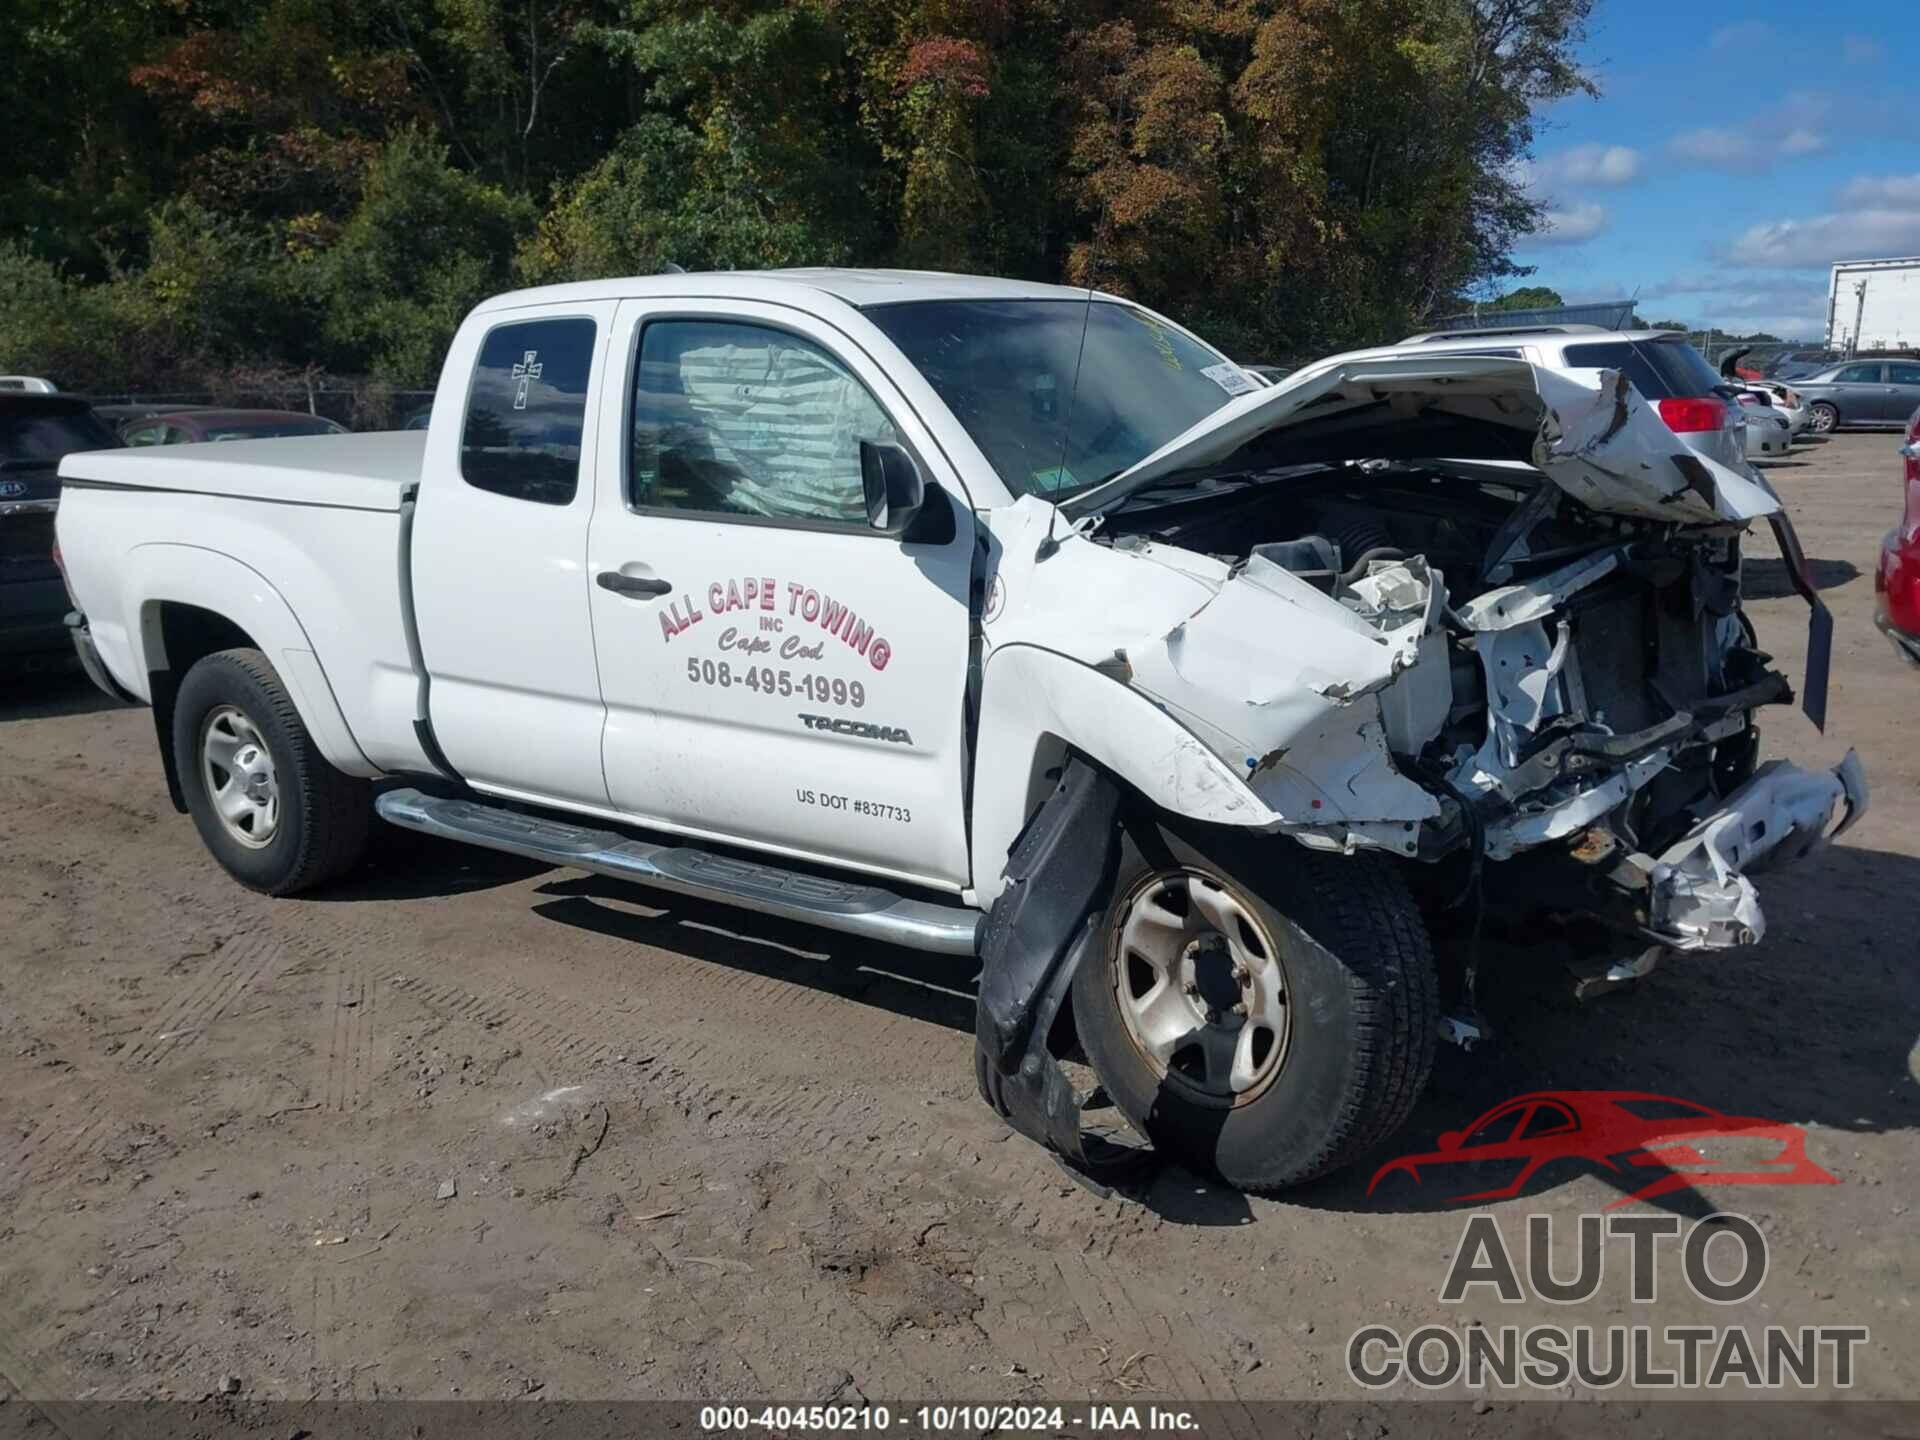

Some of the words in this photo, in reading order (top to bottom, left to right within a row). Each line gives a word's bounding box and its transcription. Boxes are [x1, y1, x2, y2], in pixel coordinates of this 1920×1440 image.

[658, 594, 703, 643] ALL
[708, 577, 776, 614] CAPE
[787, 582, 891, 671] TOWING
[759, 616, 784, 632] INC
[718, 627, 772, 656] Cape
[779, 635, 824, 660] Cod
[687, 657, 865, 708] 508-495-1999
[797, 713, 914, 746] TACOMA
[796, 789, 816, 805] US
[820, 793, 849, 811] DOT
[854, 800, 912, 823] #837733
